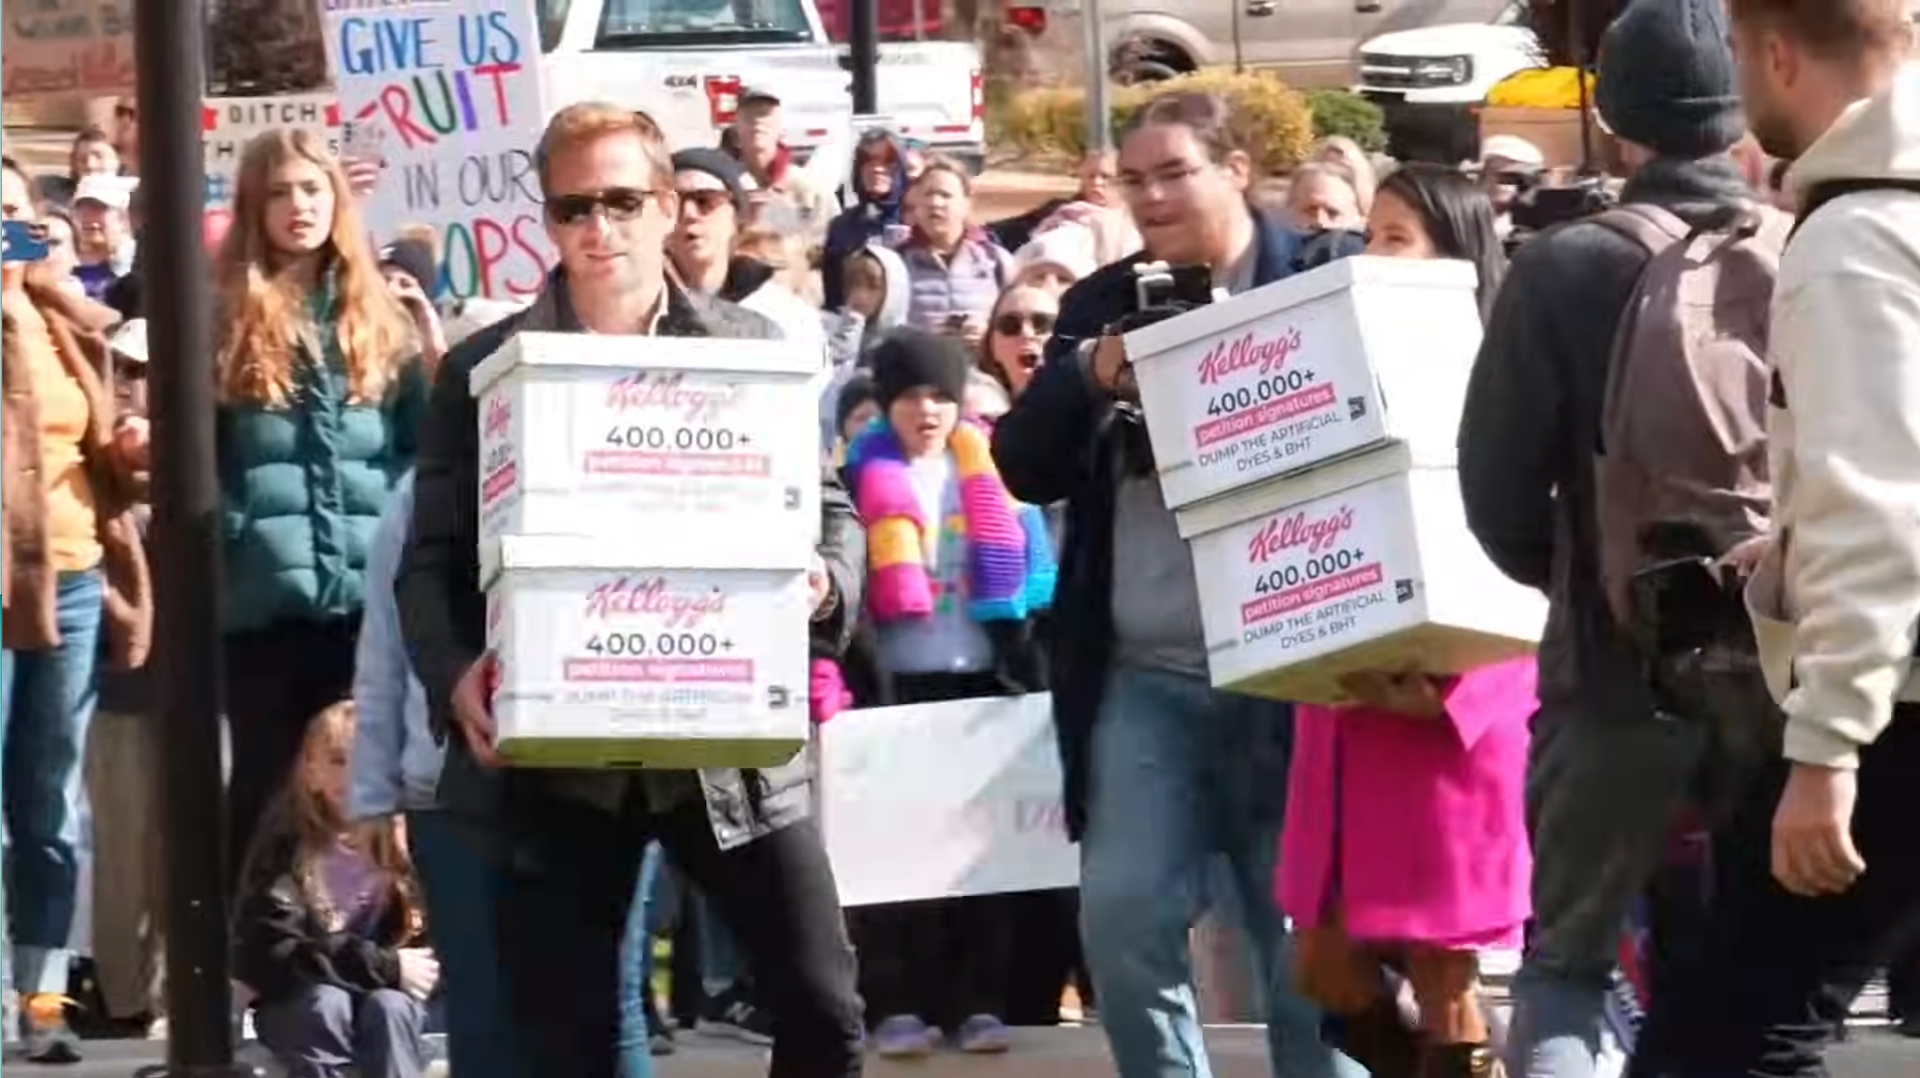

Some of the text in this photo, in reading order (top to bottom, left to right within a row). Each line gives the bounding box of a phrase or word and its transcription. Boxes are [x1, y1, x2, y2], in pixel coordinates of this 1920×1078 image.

[341, 11, 520, 75] GIVE US
[228, 102, 317, 124] DITCH
[355, 63, 523, 149] RUIT
[404, 149, 547, 210] IN OUR
[1197, 326, 1302, 385] Kellogg's
[1206, 368, 1316, 417] 400,000+
[605, 425, 751, 451] 400,000+
[1199, 412, 1341, 467] DUMP THE ARTIFICIAL
[1201, 415, 1252, 441] petition
[1236, 436, 1313, 472] DYES & BHT
[1248, 505, 1355, 563] Kellogg's
[1244, 569, 1380, 622] petition signatures
[1254, 547, 1365, 595] 400,000+
[1243, 590, 1386, 645] DUMP THE ARTIFICIAL
[1280, 615, 1359, 650] DYES & BHT
[585, 632, 736, 657] 400,000+
